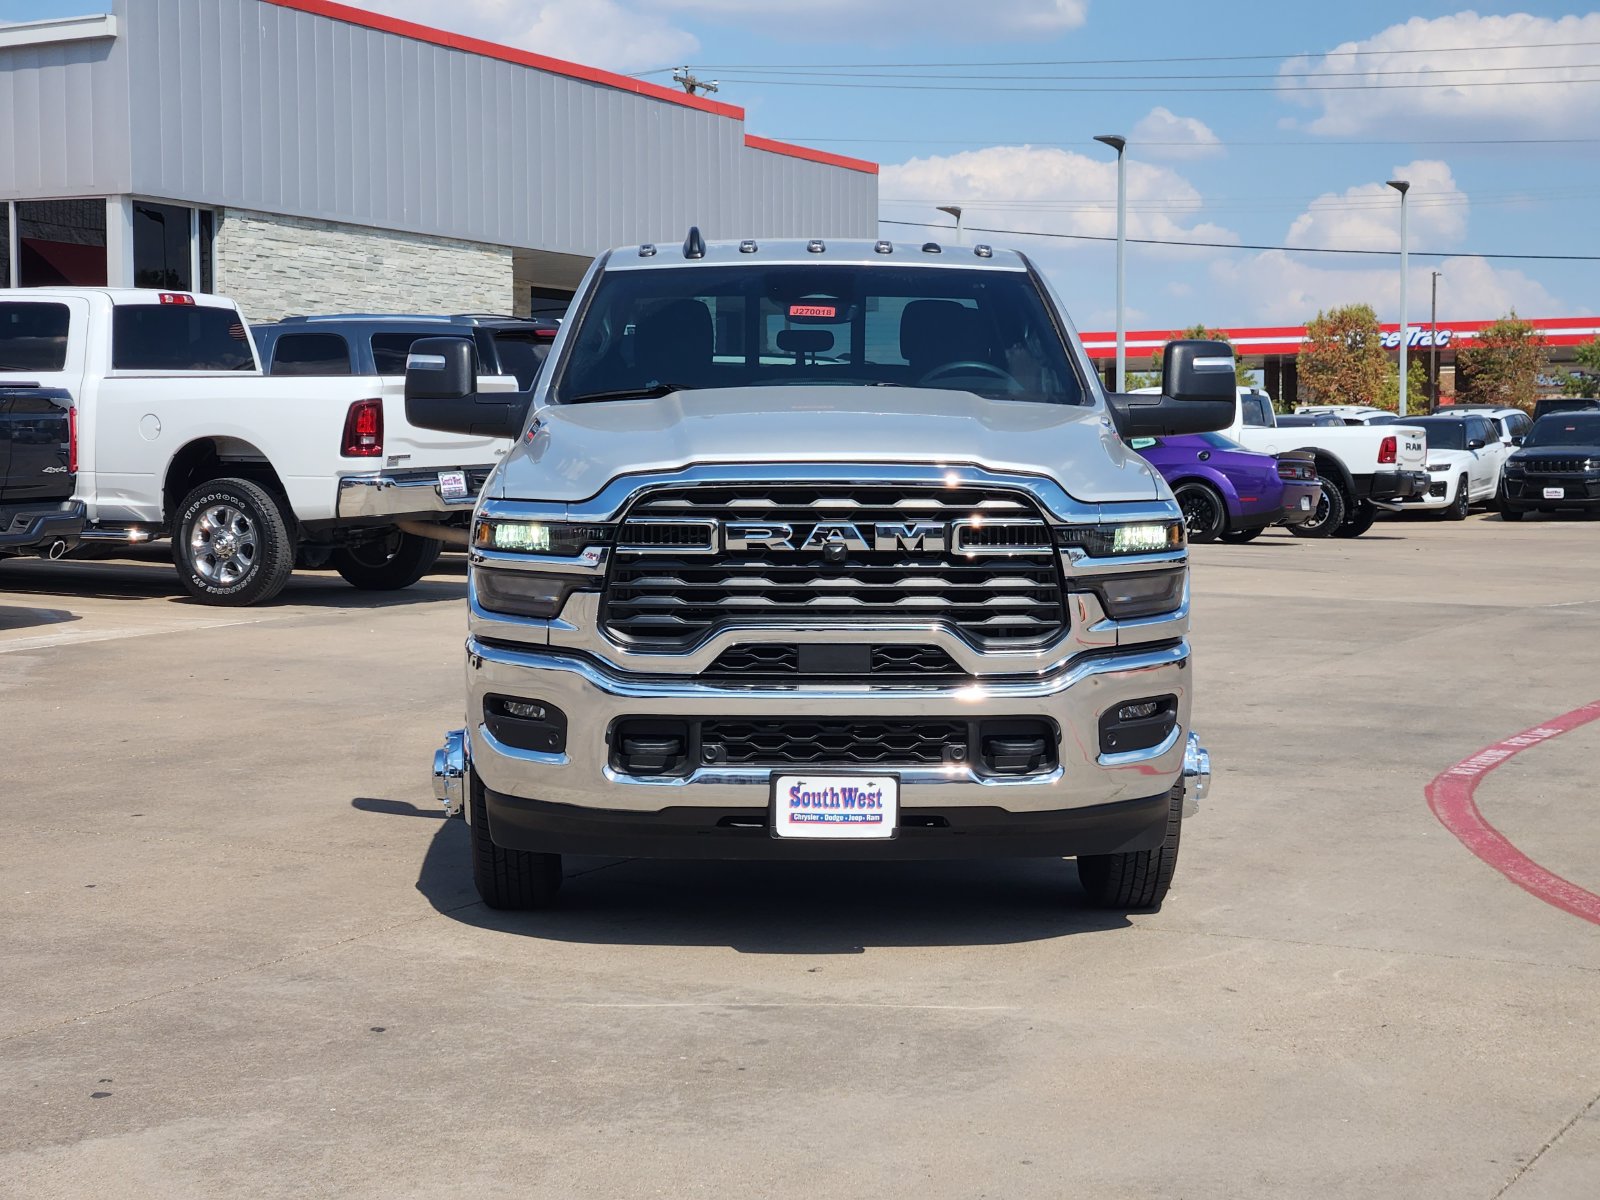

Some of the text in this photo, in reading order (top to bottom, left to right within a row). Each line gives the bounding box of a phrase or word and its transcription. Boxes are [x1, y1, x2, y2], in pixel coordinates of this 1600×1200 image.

[1405, 443, 1422, 451] RAM
[724, 522, 946, 551] RAM
[793, 813, 881, 823] Chrysler Dodge Jeep Ram
